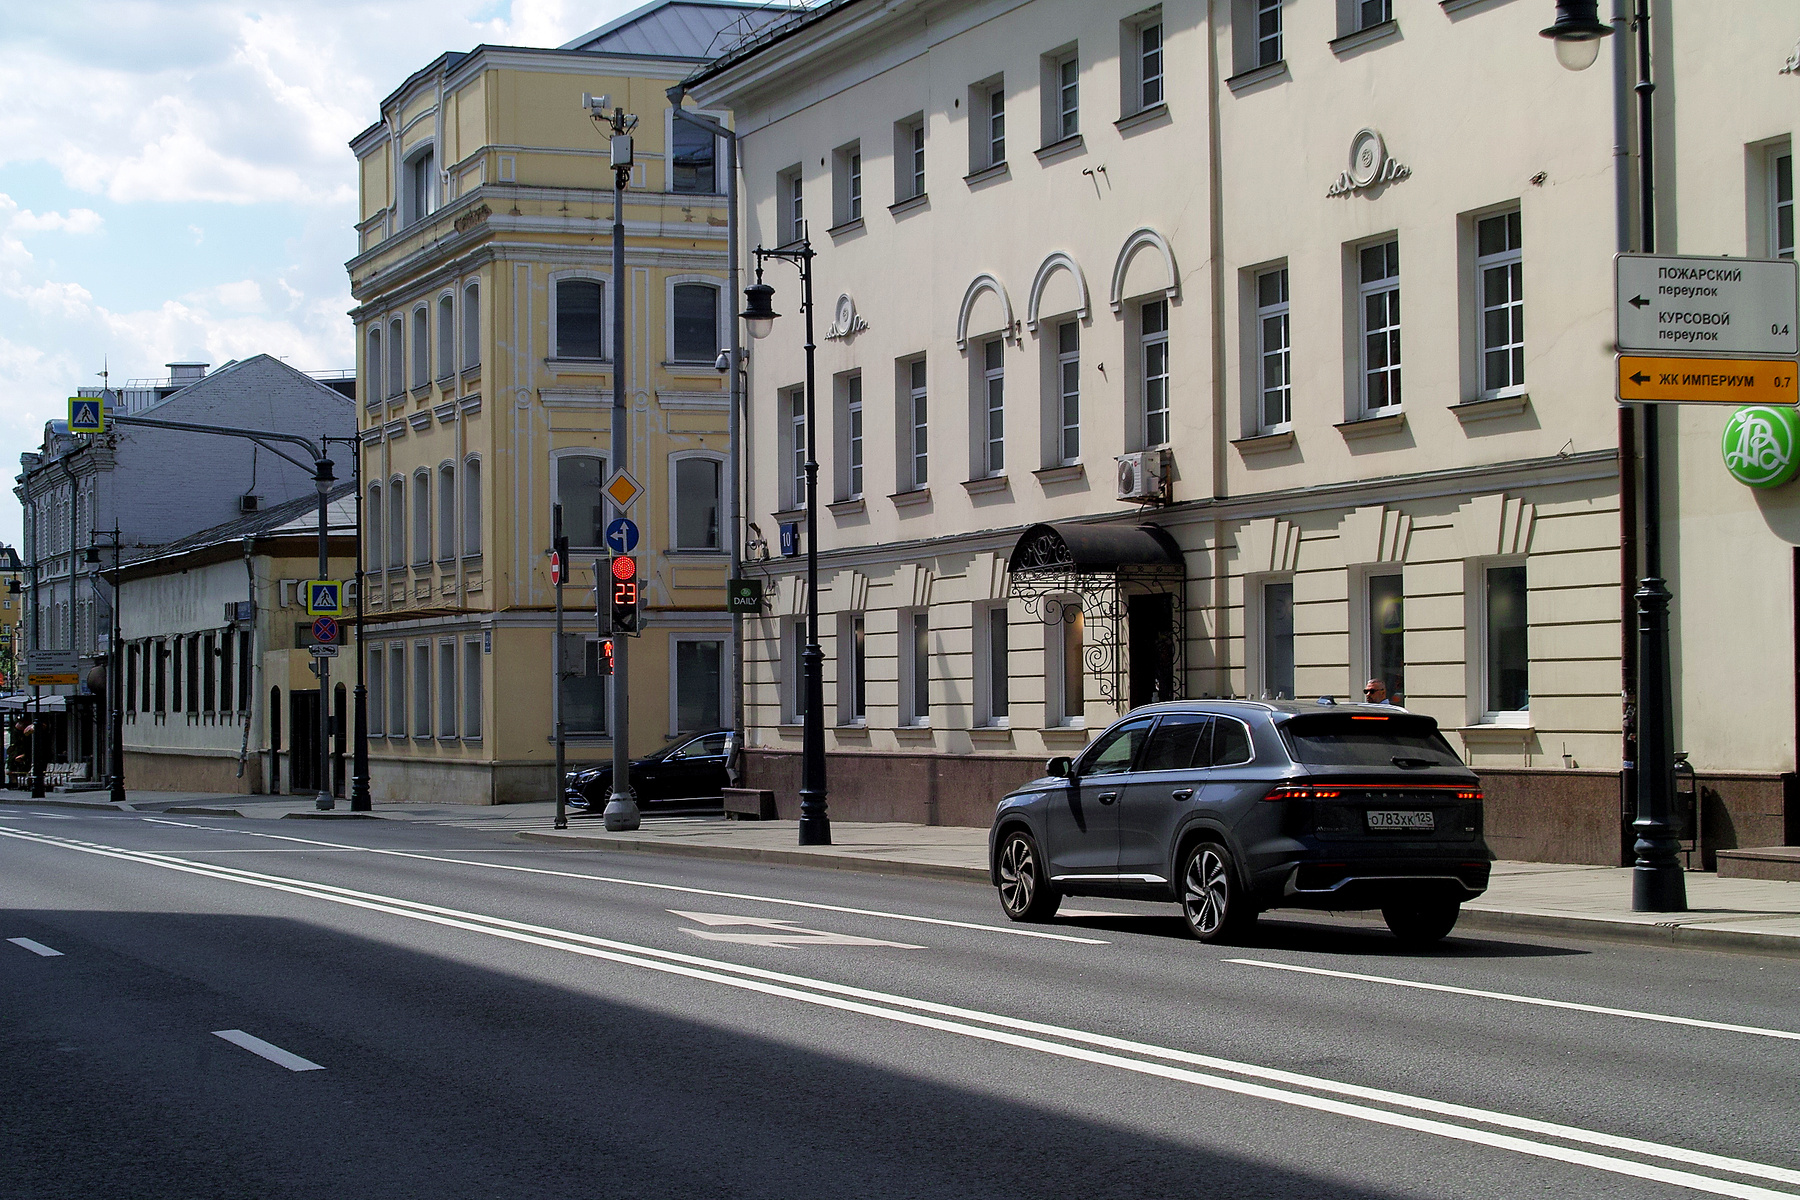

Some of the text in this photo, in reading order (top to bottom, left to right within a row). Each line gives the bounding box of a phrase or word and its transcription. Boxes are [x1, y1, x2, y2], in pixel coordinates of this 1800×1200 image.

[1658, 267, 1742, 282] ПОЖАРСКИЙ
[1658, 285, 1718, 298] переулок
[1658, 311, 1730, 325] КУРСОВОЙ
[1659, 330, 1718, 342] переулок
[1771, 323, 1789, 336] 0.4
[1659, 373, 1754, 387] ЖК ИМПЕРИУМ
[1773, 376, 1791, 388] 0.7
[782, 532, 791, 547] 10
[615, 583, 636, 605] 23
[733, 596, 757, 605] DAILY
